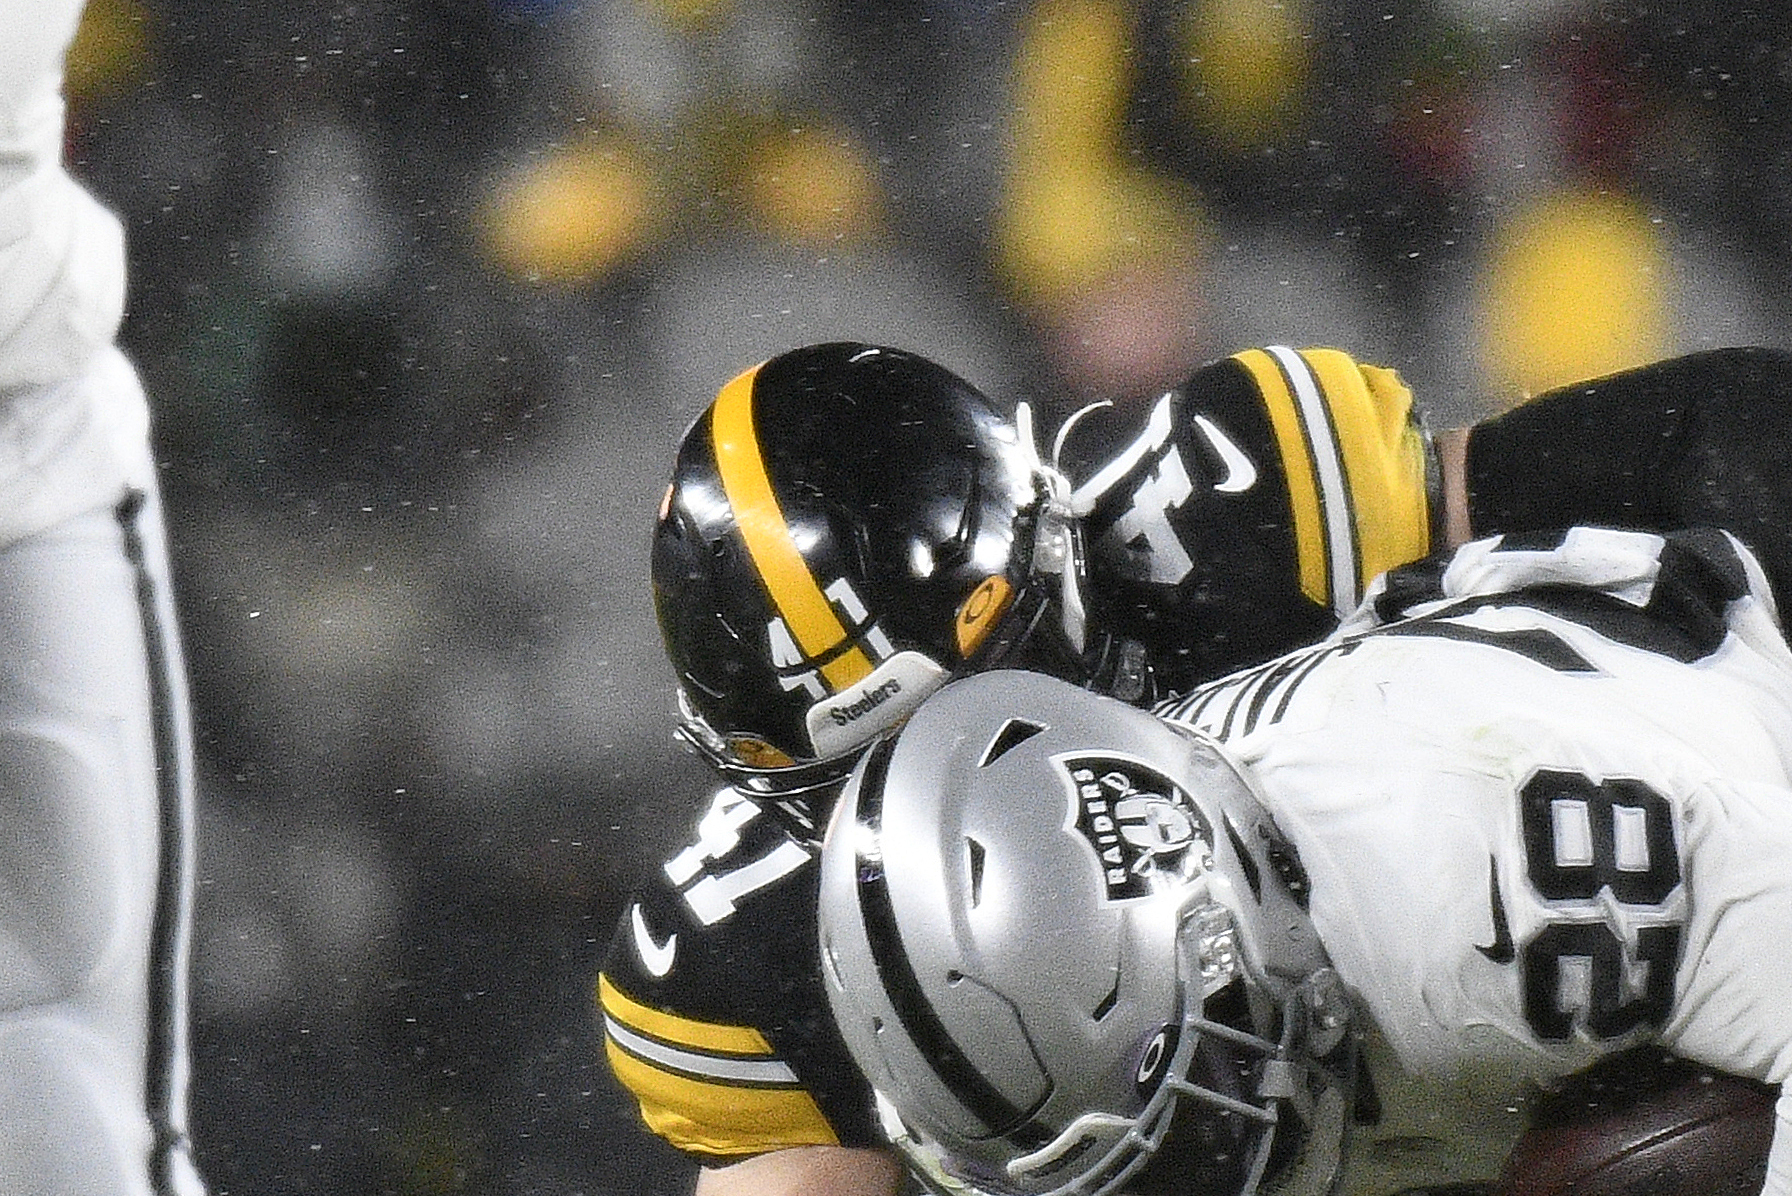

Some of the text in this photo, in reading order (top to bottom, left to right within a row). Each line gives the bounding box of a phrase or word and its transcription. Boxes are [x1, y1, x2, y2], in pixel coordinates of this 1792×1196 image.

[767, 577, 895, 700] 41
[829, 678, 901, 726] Steelers
[663, 786, 812, 926] 41
[1073, 769, 1127, 884] RAIDERS
[1512, 766, 1684, 1047] 28
